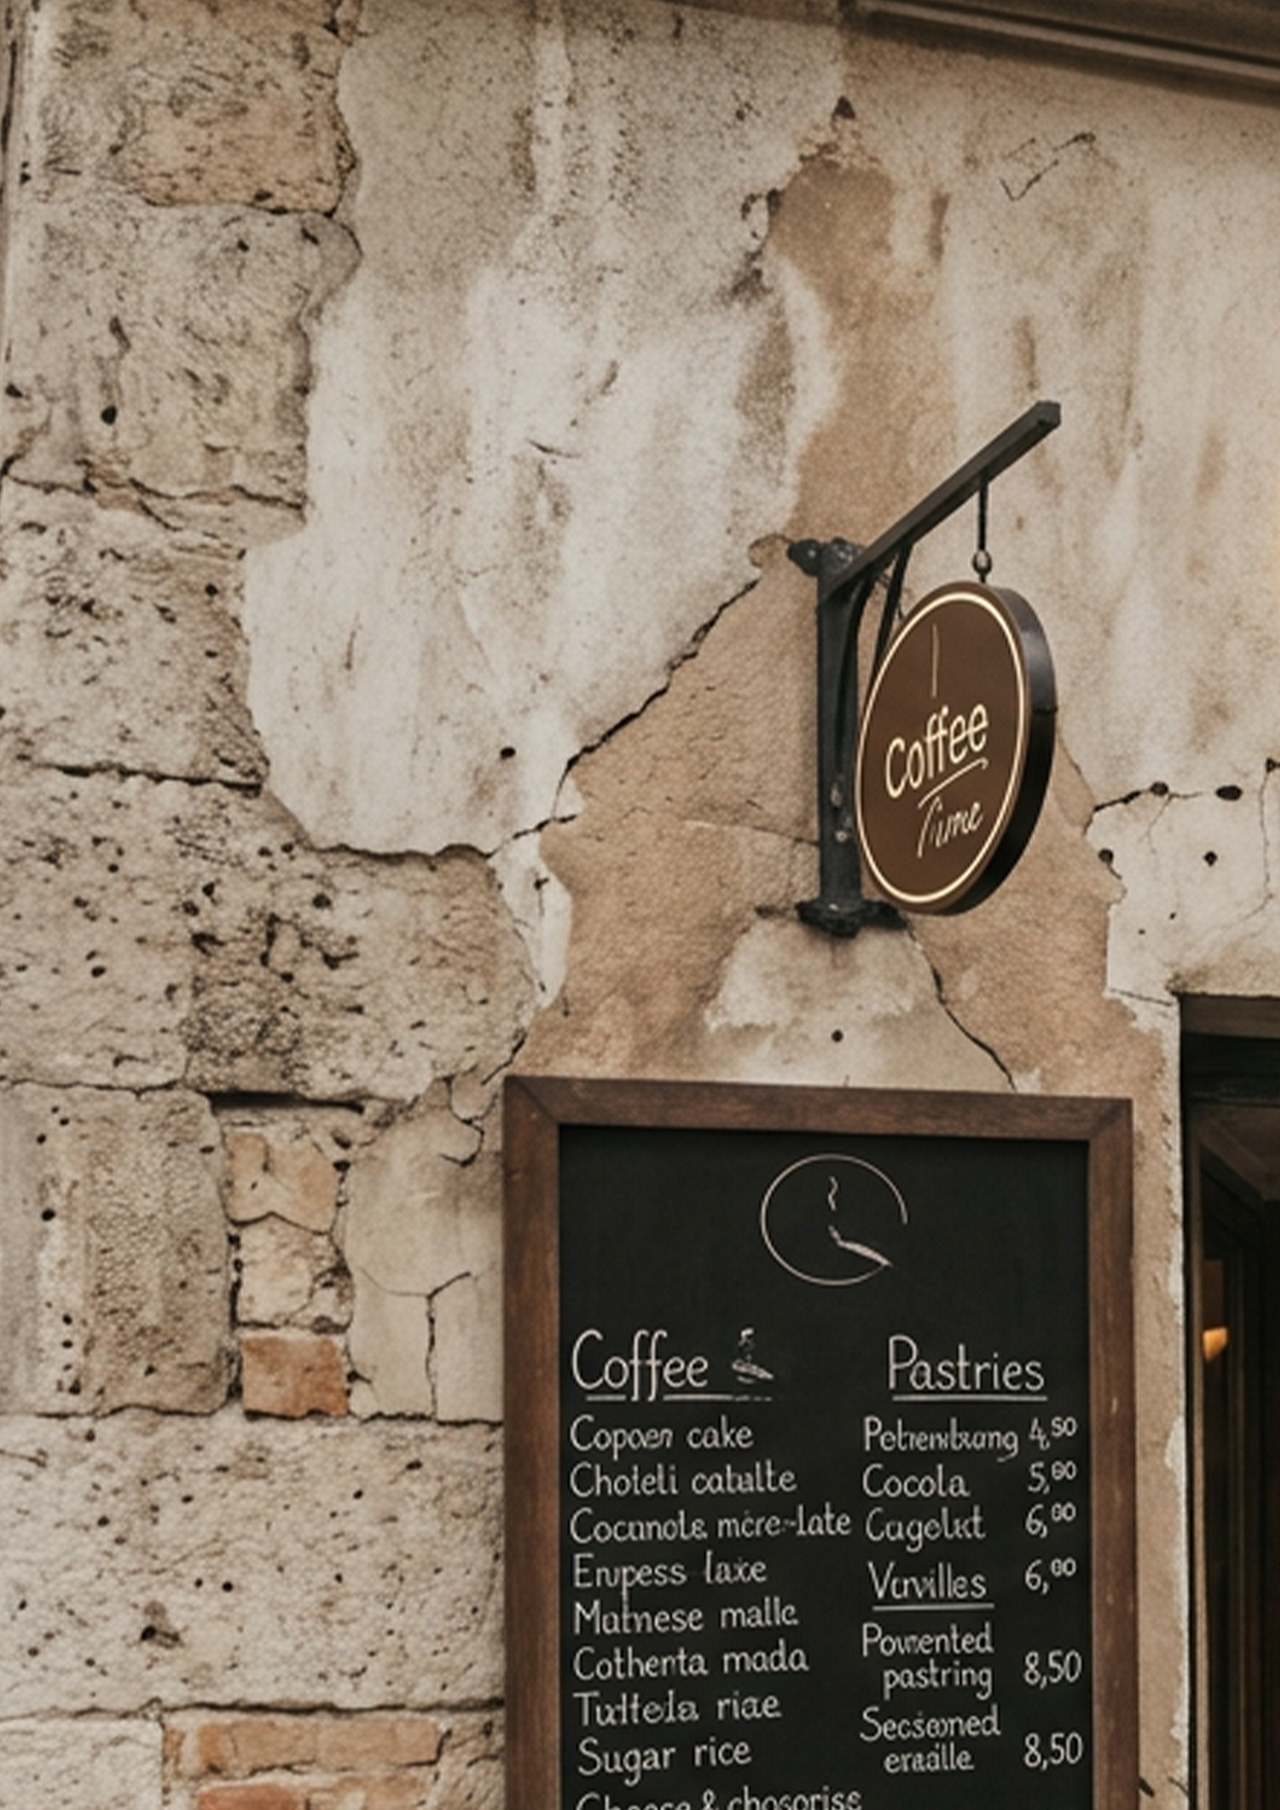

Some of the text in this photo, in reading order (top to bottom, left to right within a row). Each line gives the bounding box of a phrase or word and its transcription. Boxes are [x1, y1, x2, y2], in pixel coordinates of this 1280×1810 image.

[885, 704, 988, 798] Coffee
[572, 1329, 709, 1401] Coffee
[888, 1334, 1045, 1391] Pastries
[686, 1414, 754, 1449] cake
[862, 1463, 971, 1498] Cocola
[723, 1638, 810, 1674] mada
[883, 1650, 1082, 1701] pastring 8,50
[578, 1736, 752, 1787] Sugar rice
[1024, 1732, 1083, 1770] 8,50
